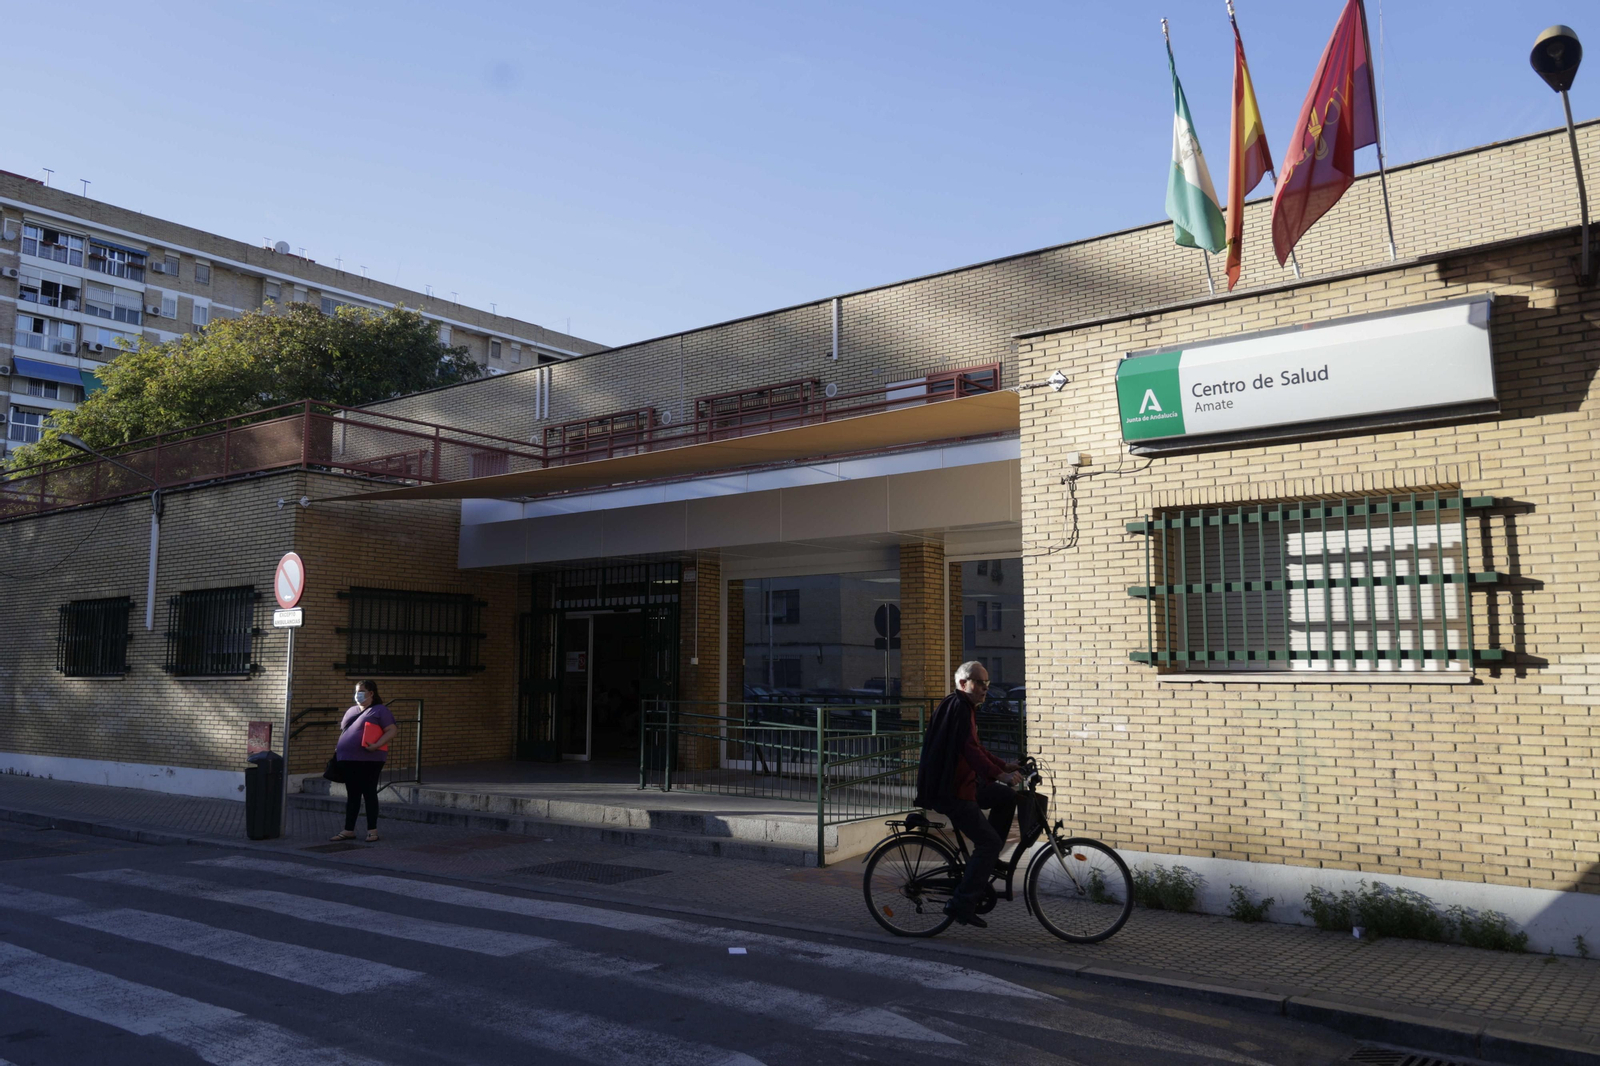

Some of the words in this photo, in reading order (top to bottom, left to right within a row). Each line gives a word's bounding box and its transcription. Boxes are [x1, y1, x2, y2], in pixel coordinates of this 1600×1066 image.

[1192, 380, 1246, 398] Centro
[1252, 374, 1274, 390] de
[1280, 364, 1329, 386] Salud
[1194, 399, 1234, 413] Amate
[1150, 411, 1178, 420] Andalucía
